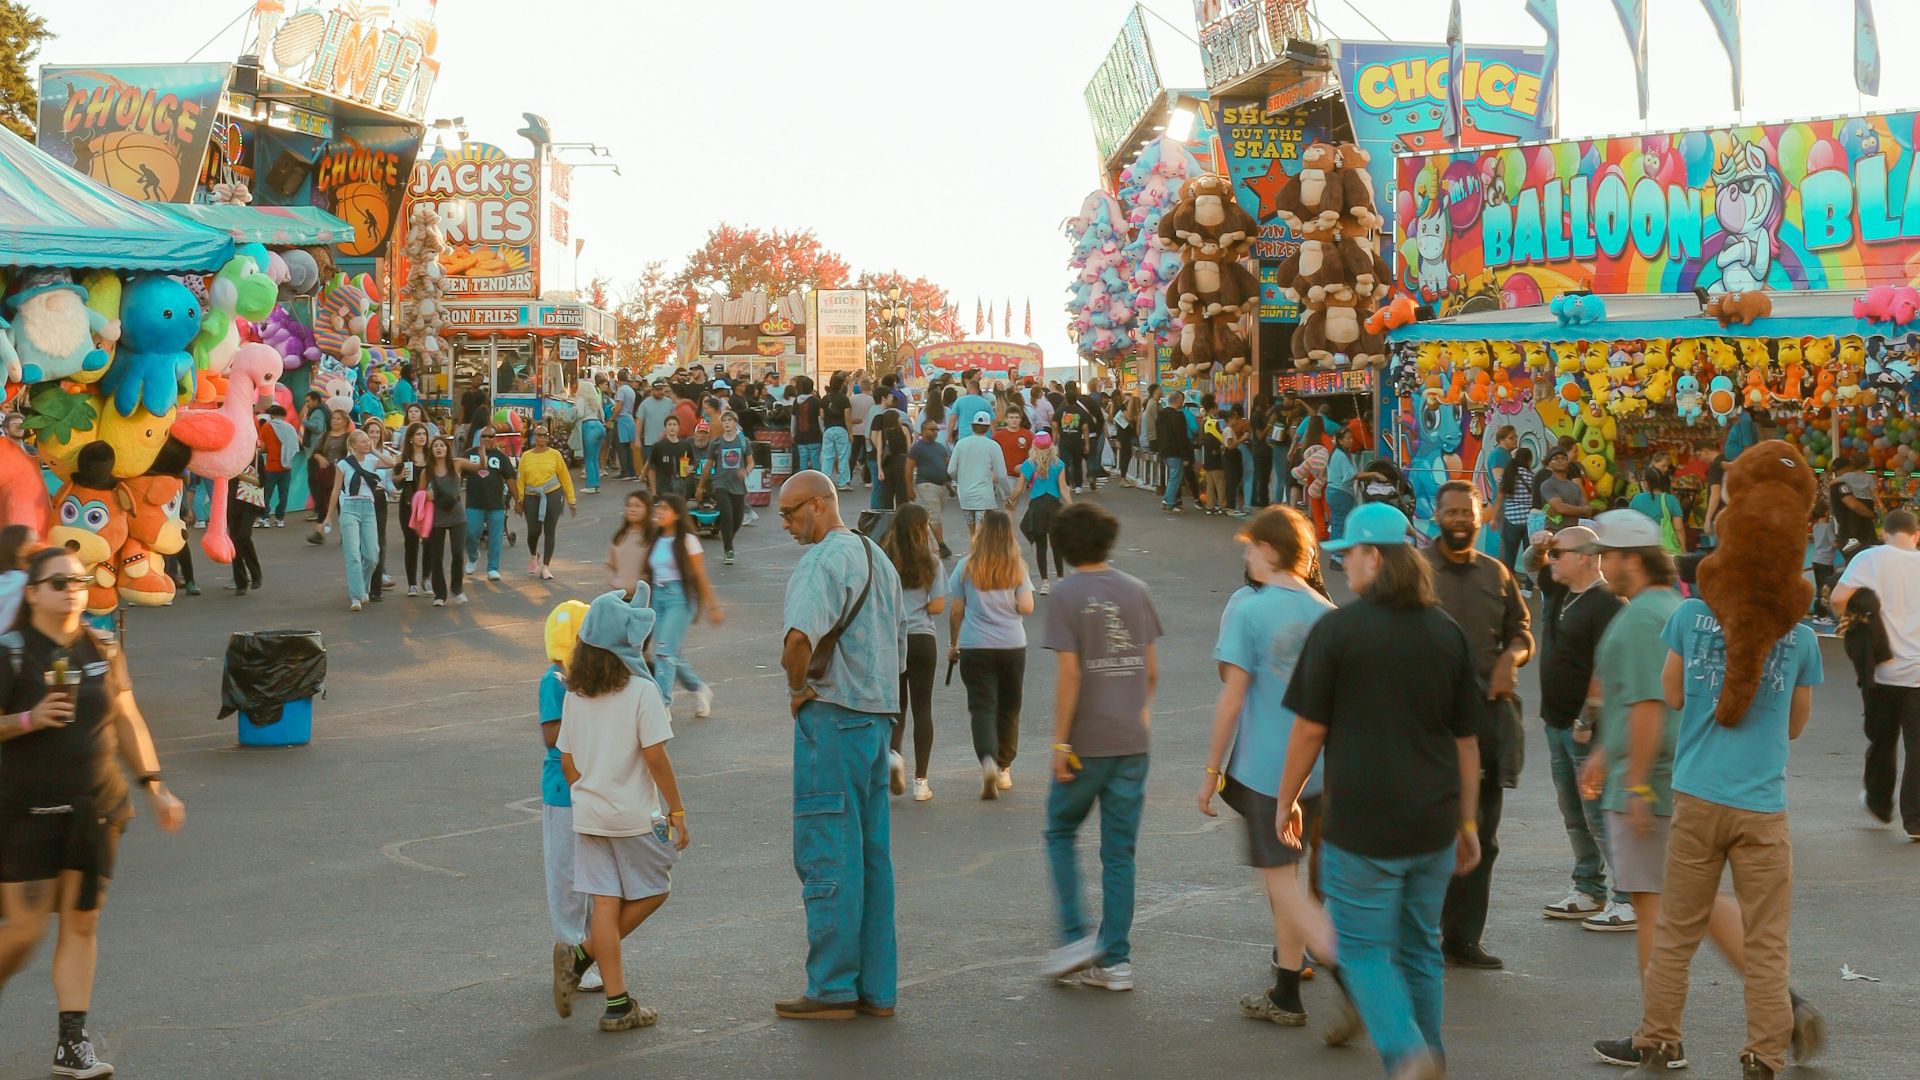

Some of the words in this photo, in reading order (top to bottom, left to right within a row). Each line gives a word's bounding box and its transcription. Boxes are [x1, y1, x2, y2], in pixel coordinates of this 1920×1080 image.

[308, 8, 421, 111] HOOPS
[1358, 58, 1542, 116] CHOICE
[63, 86, 200, 143] CHOICE
[1231, 128, 1263, 139] OUT
[1268, 128, 1302, 141] THE
[1234, 141, 1297, 159] STAR
[319, 148, 399, 192] CHOICE
[412, 163, 534, 194] JACK'S
[1482, 173, 1701, 268] BALLOON
[472, 271, 532, 292] TENDERS
[475, 309, 519, 323] FRIES
